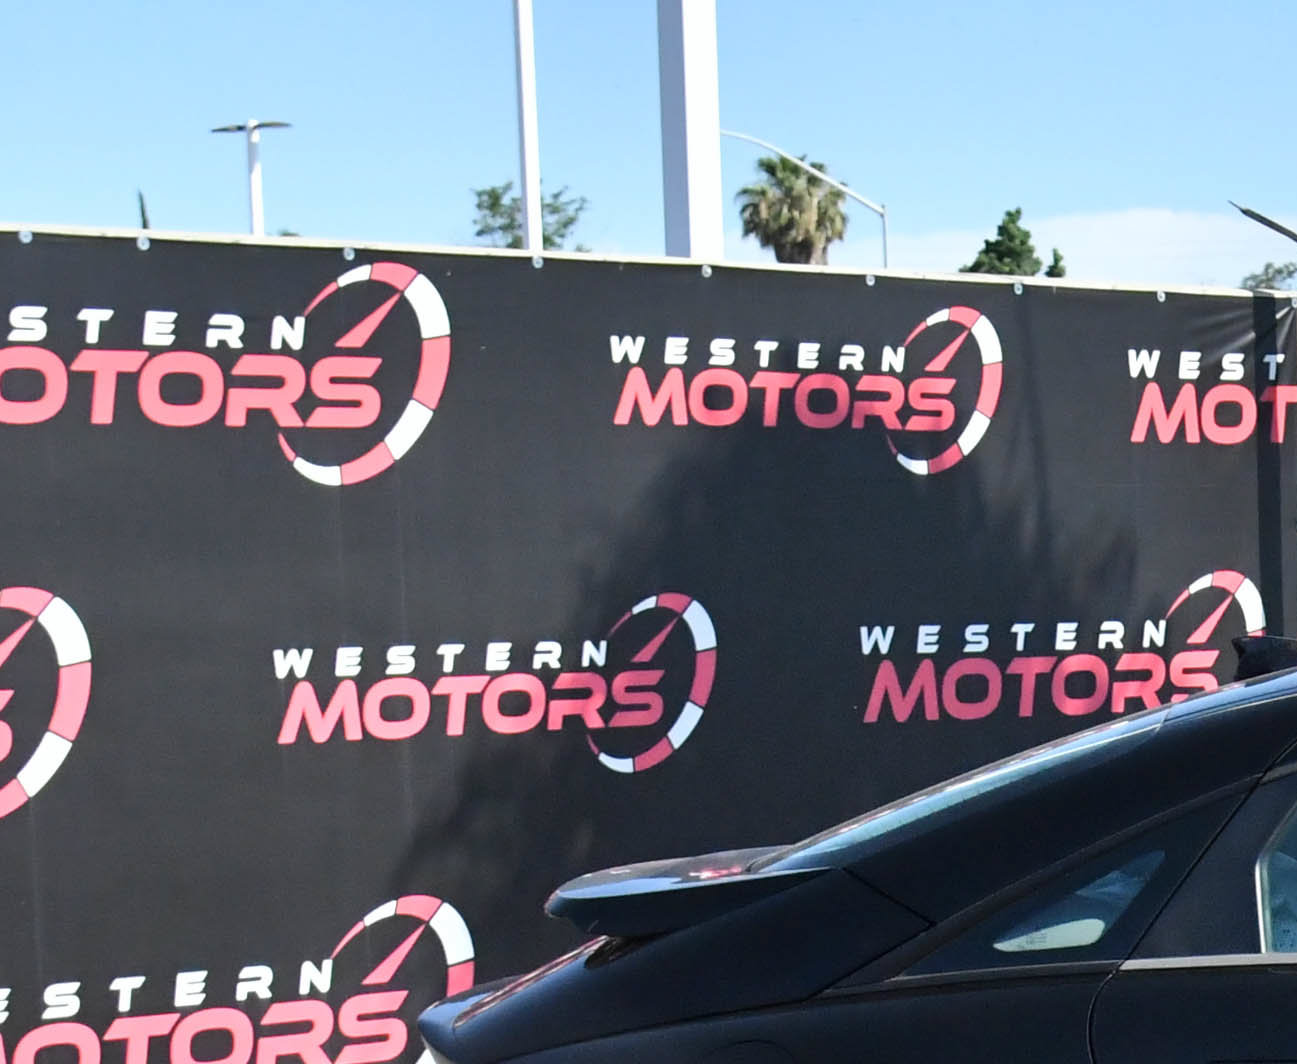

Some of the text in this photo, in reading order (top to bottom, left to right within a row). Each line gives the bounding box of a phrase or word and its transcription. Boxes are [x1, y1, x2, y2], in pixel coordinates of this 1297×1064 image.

[609, 335, 906, 374] WESTERN
[1127, 349, 1286, 381] WEST
[612, 366, 957, 432] MOTORS
[859, 620, 1168, 656] WESTERN
[272, 639, 608, 679] WESTERN
[863, 649, 1221, 724] MOTORS
[276, 669, 665, 745] MOTORS
